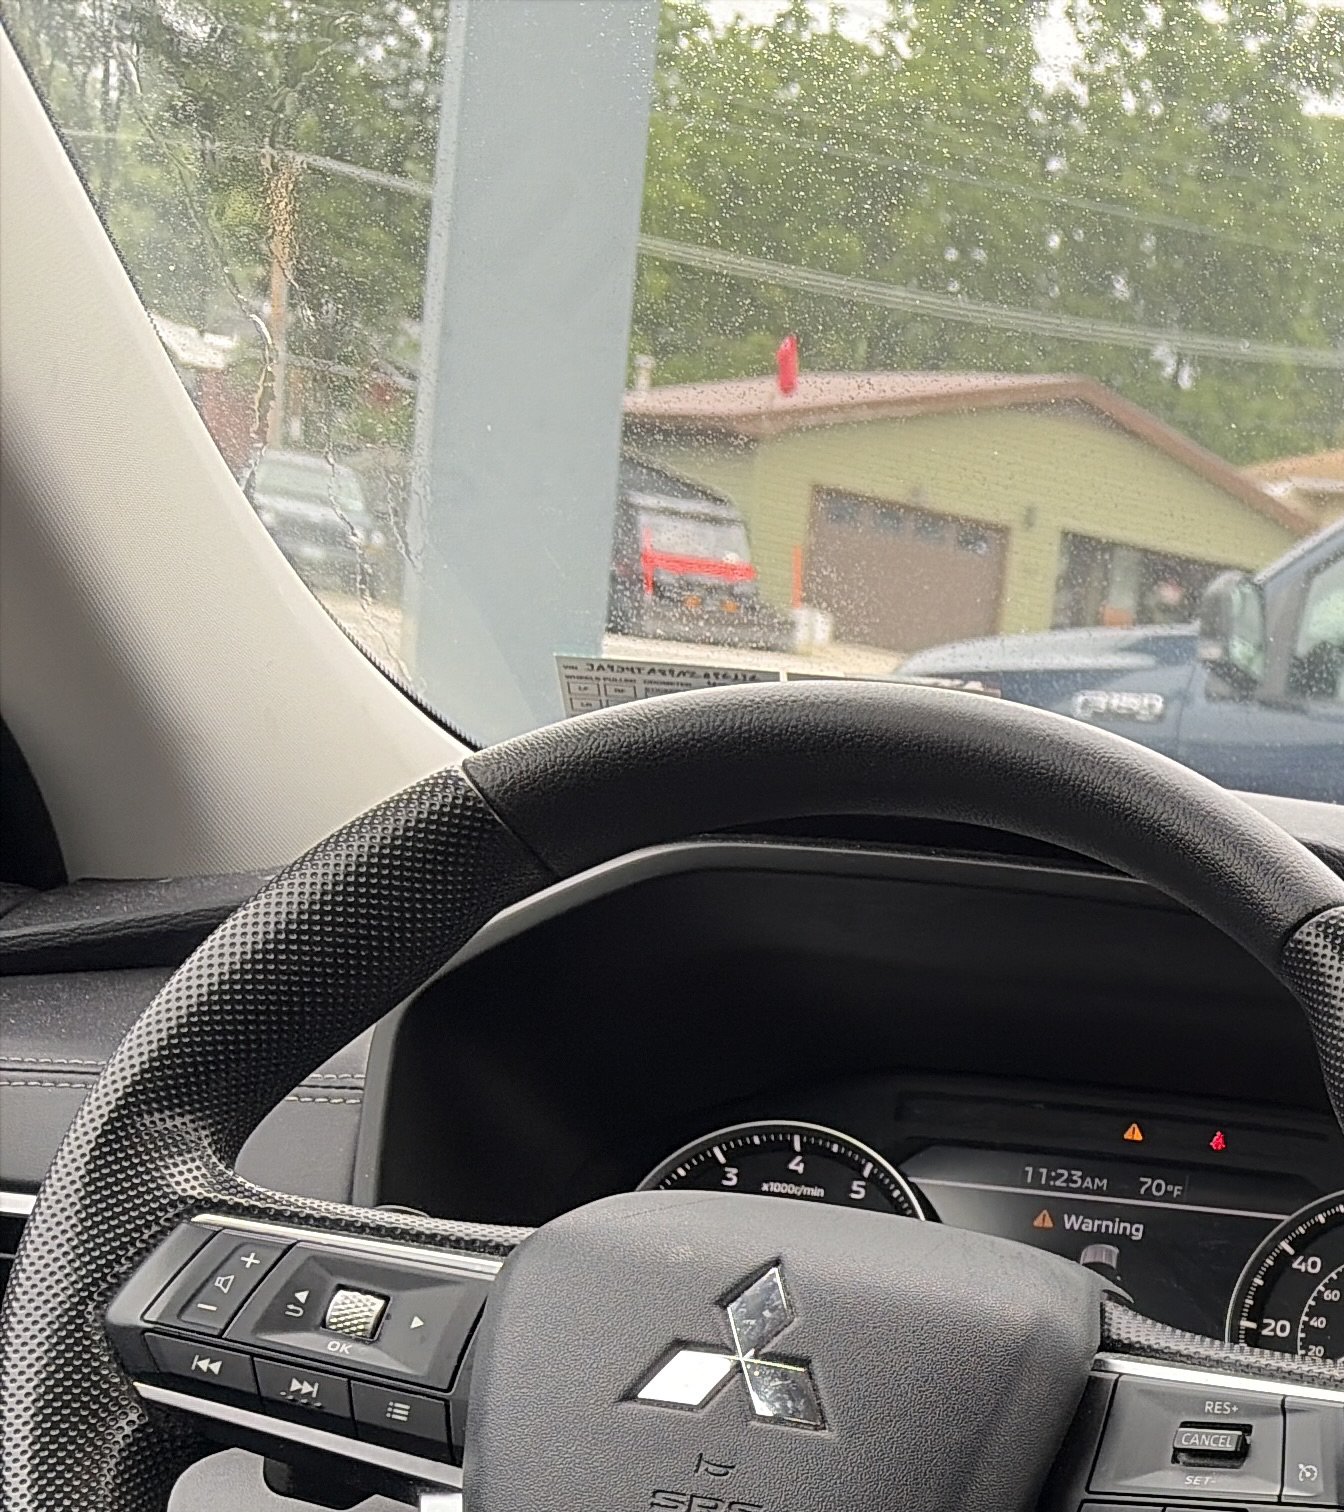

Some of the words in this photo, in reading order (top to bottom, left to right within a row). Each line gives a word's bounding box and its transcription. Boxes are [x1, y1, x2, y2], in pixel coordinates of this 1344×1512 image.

[788, 1156, 805, 1174] 4
[721, 1167, 739, 1186] 3
[849, 1181, 867, 1199] 5
[1063, 1213, 1144, 1241] Warning
[1291, 1255, 1322, 1274] 40
[1323, 1289, 1341, 1301] 60
[1261, 1318, 1291, 1338] 20
[1309, 1316, 1327, 1329] 40
[326, 1339, 353, 1356] OK
[1307, 1344, 1325, 1358] 20
[1204, 1401, 1239, 1415] RES+
[1181, 1432, 1233, 1449] CANCEL
